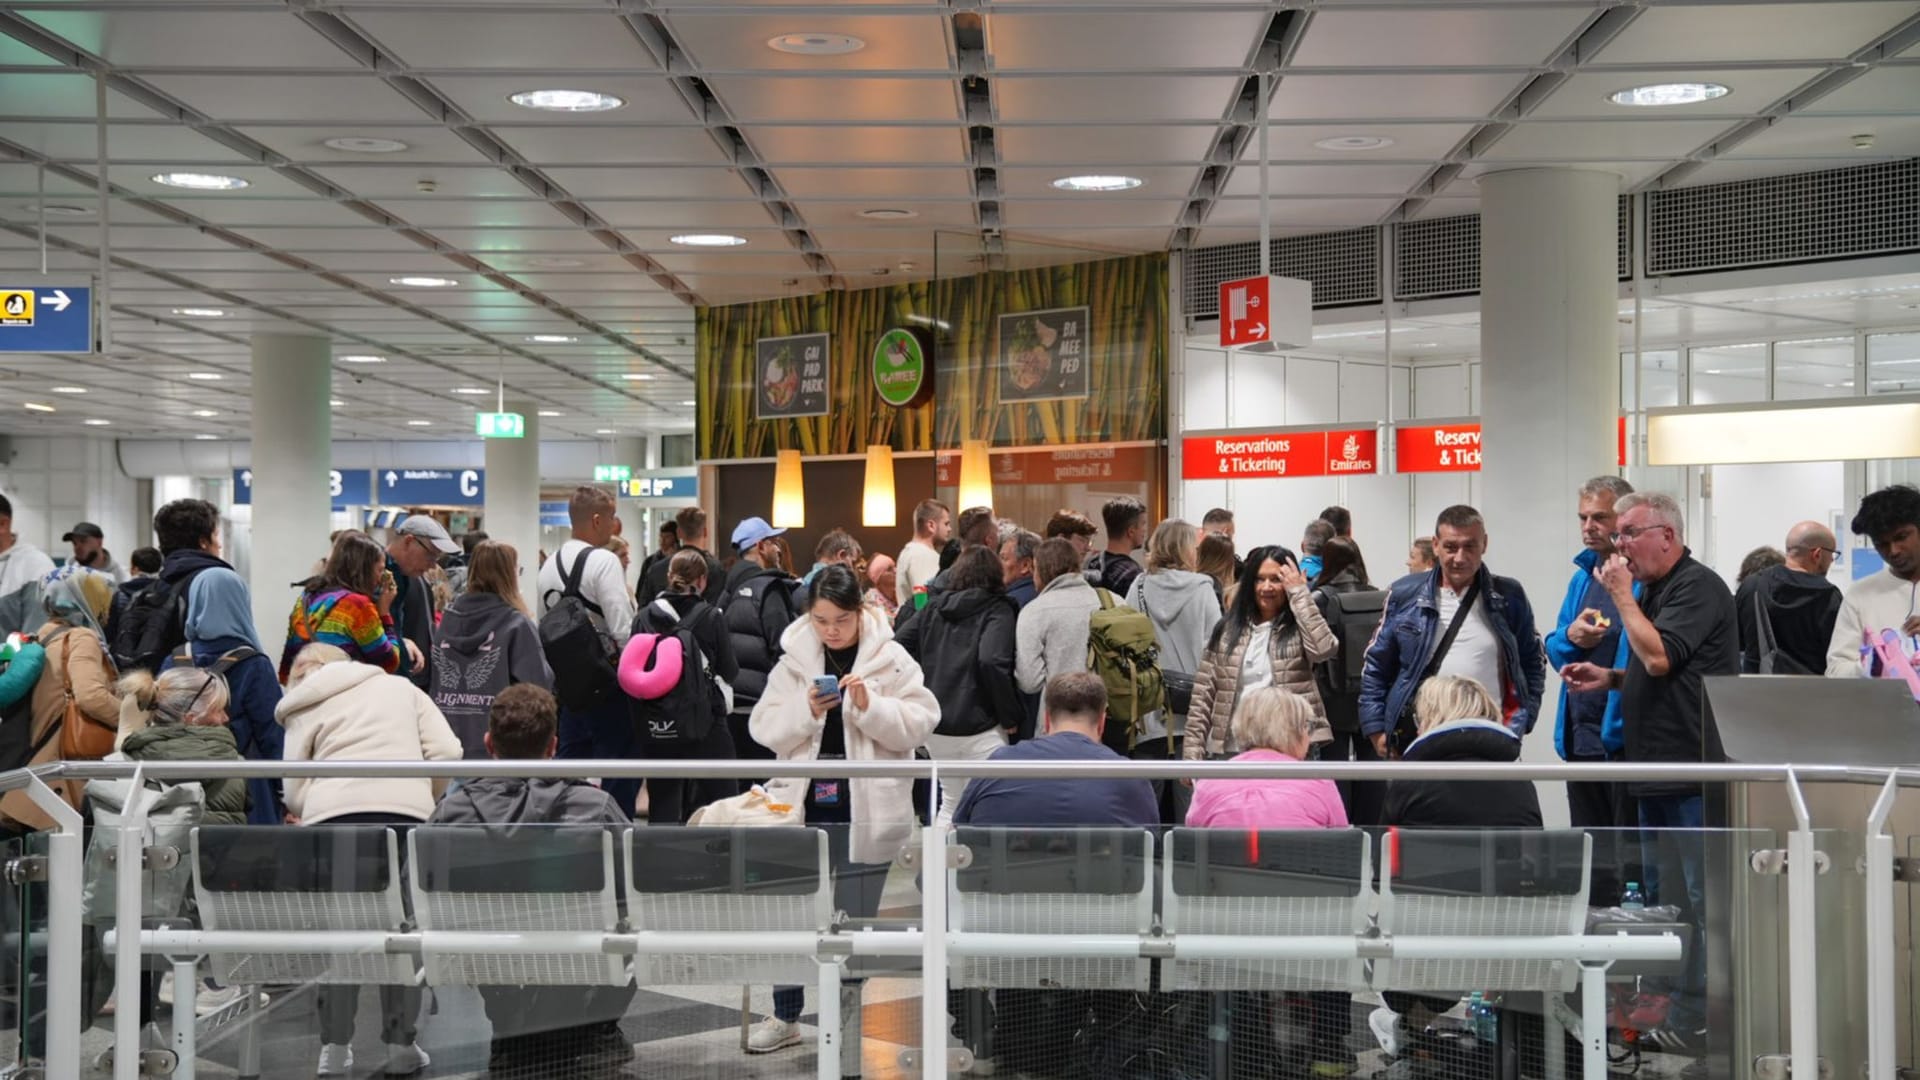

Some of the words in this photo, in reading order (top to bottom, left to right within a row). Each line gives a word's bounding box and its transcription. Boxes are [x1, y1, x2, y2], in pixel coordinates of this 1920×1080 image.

[1063, 321, 1077, 337] BA
[804, 346, 820, 362] GAI
[1058, 339, 1081, 356] MEE
[803, 363, 821, 378] PAD
[1060, 358, 1080, 375] PED
[801, 378, 824, 394] PARK
[1216, 438, 1290, 455] Reservations
[1330, 459, 1371, 471] Emirates
[1440, 449, 1451, 465] &
[1218, 458, 1229, 473] &
[1231, 457, 1286, 474] Ticketing
[460, 469, 479, 498] C
